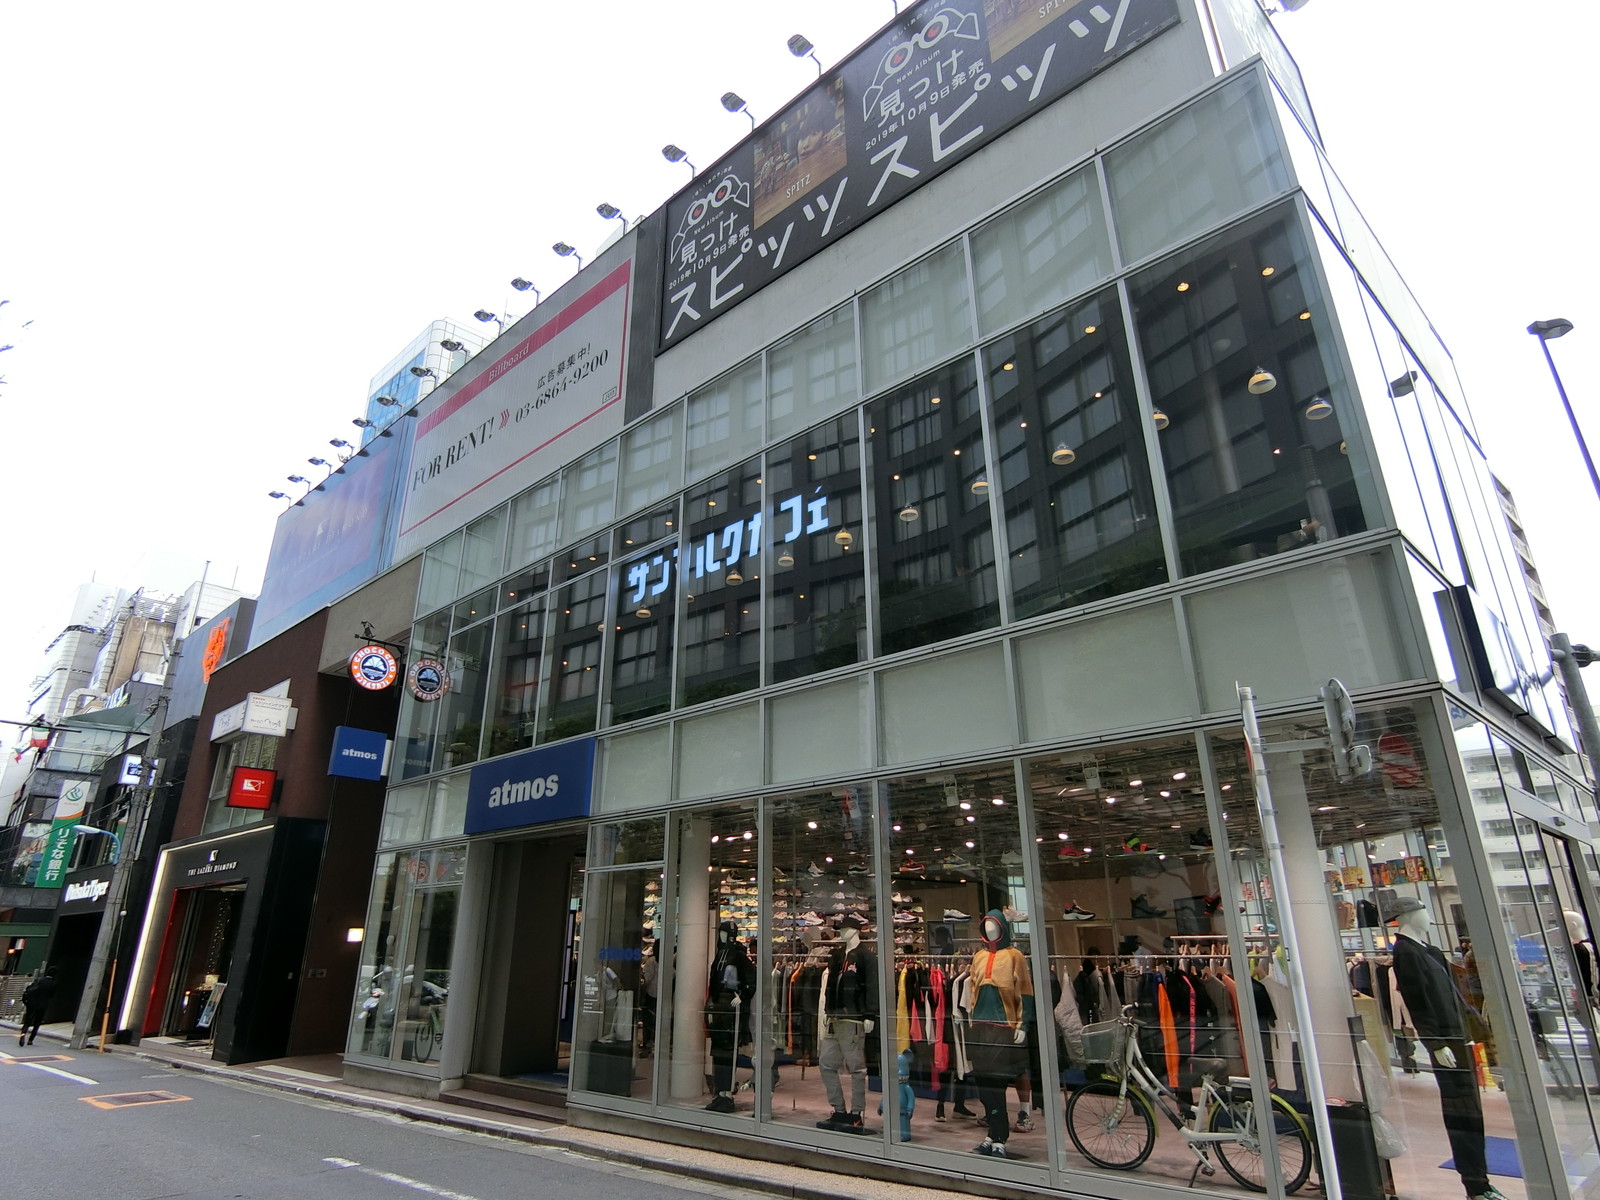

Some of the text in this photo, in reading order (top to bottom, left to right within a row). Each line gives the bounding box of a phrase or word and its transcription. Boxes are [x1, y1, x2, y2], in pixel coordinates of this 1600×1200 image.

[896, 49, 941, 85] New Album
[865, 58, 985, 151] 2019年10月9日発売
[785, 173, 812, 199] SPITZ
[693, 210, 725, 236] New Album
[668, 224, 751, 290] 2019年10月9日発売
[489, 342, 530, 382] Billboard
[515, 349, 609, 424] 03-6864-9200
[412, 416, 496, 493] FOR RENT!
[628, 485, 829, 604] サンルクカフェ
[353, 646, 396, 672] CHOCOCRO
[341, 747, 378, 761] atmos
[487, 773, 560, 809] atmos
[45, 828, 70, 881] りそな銀行
